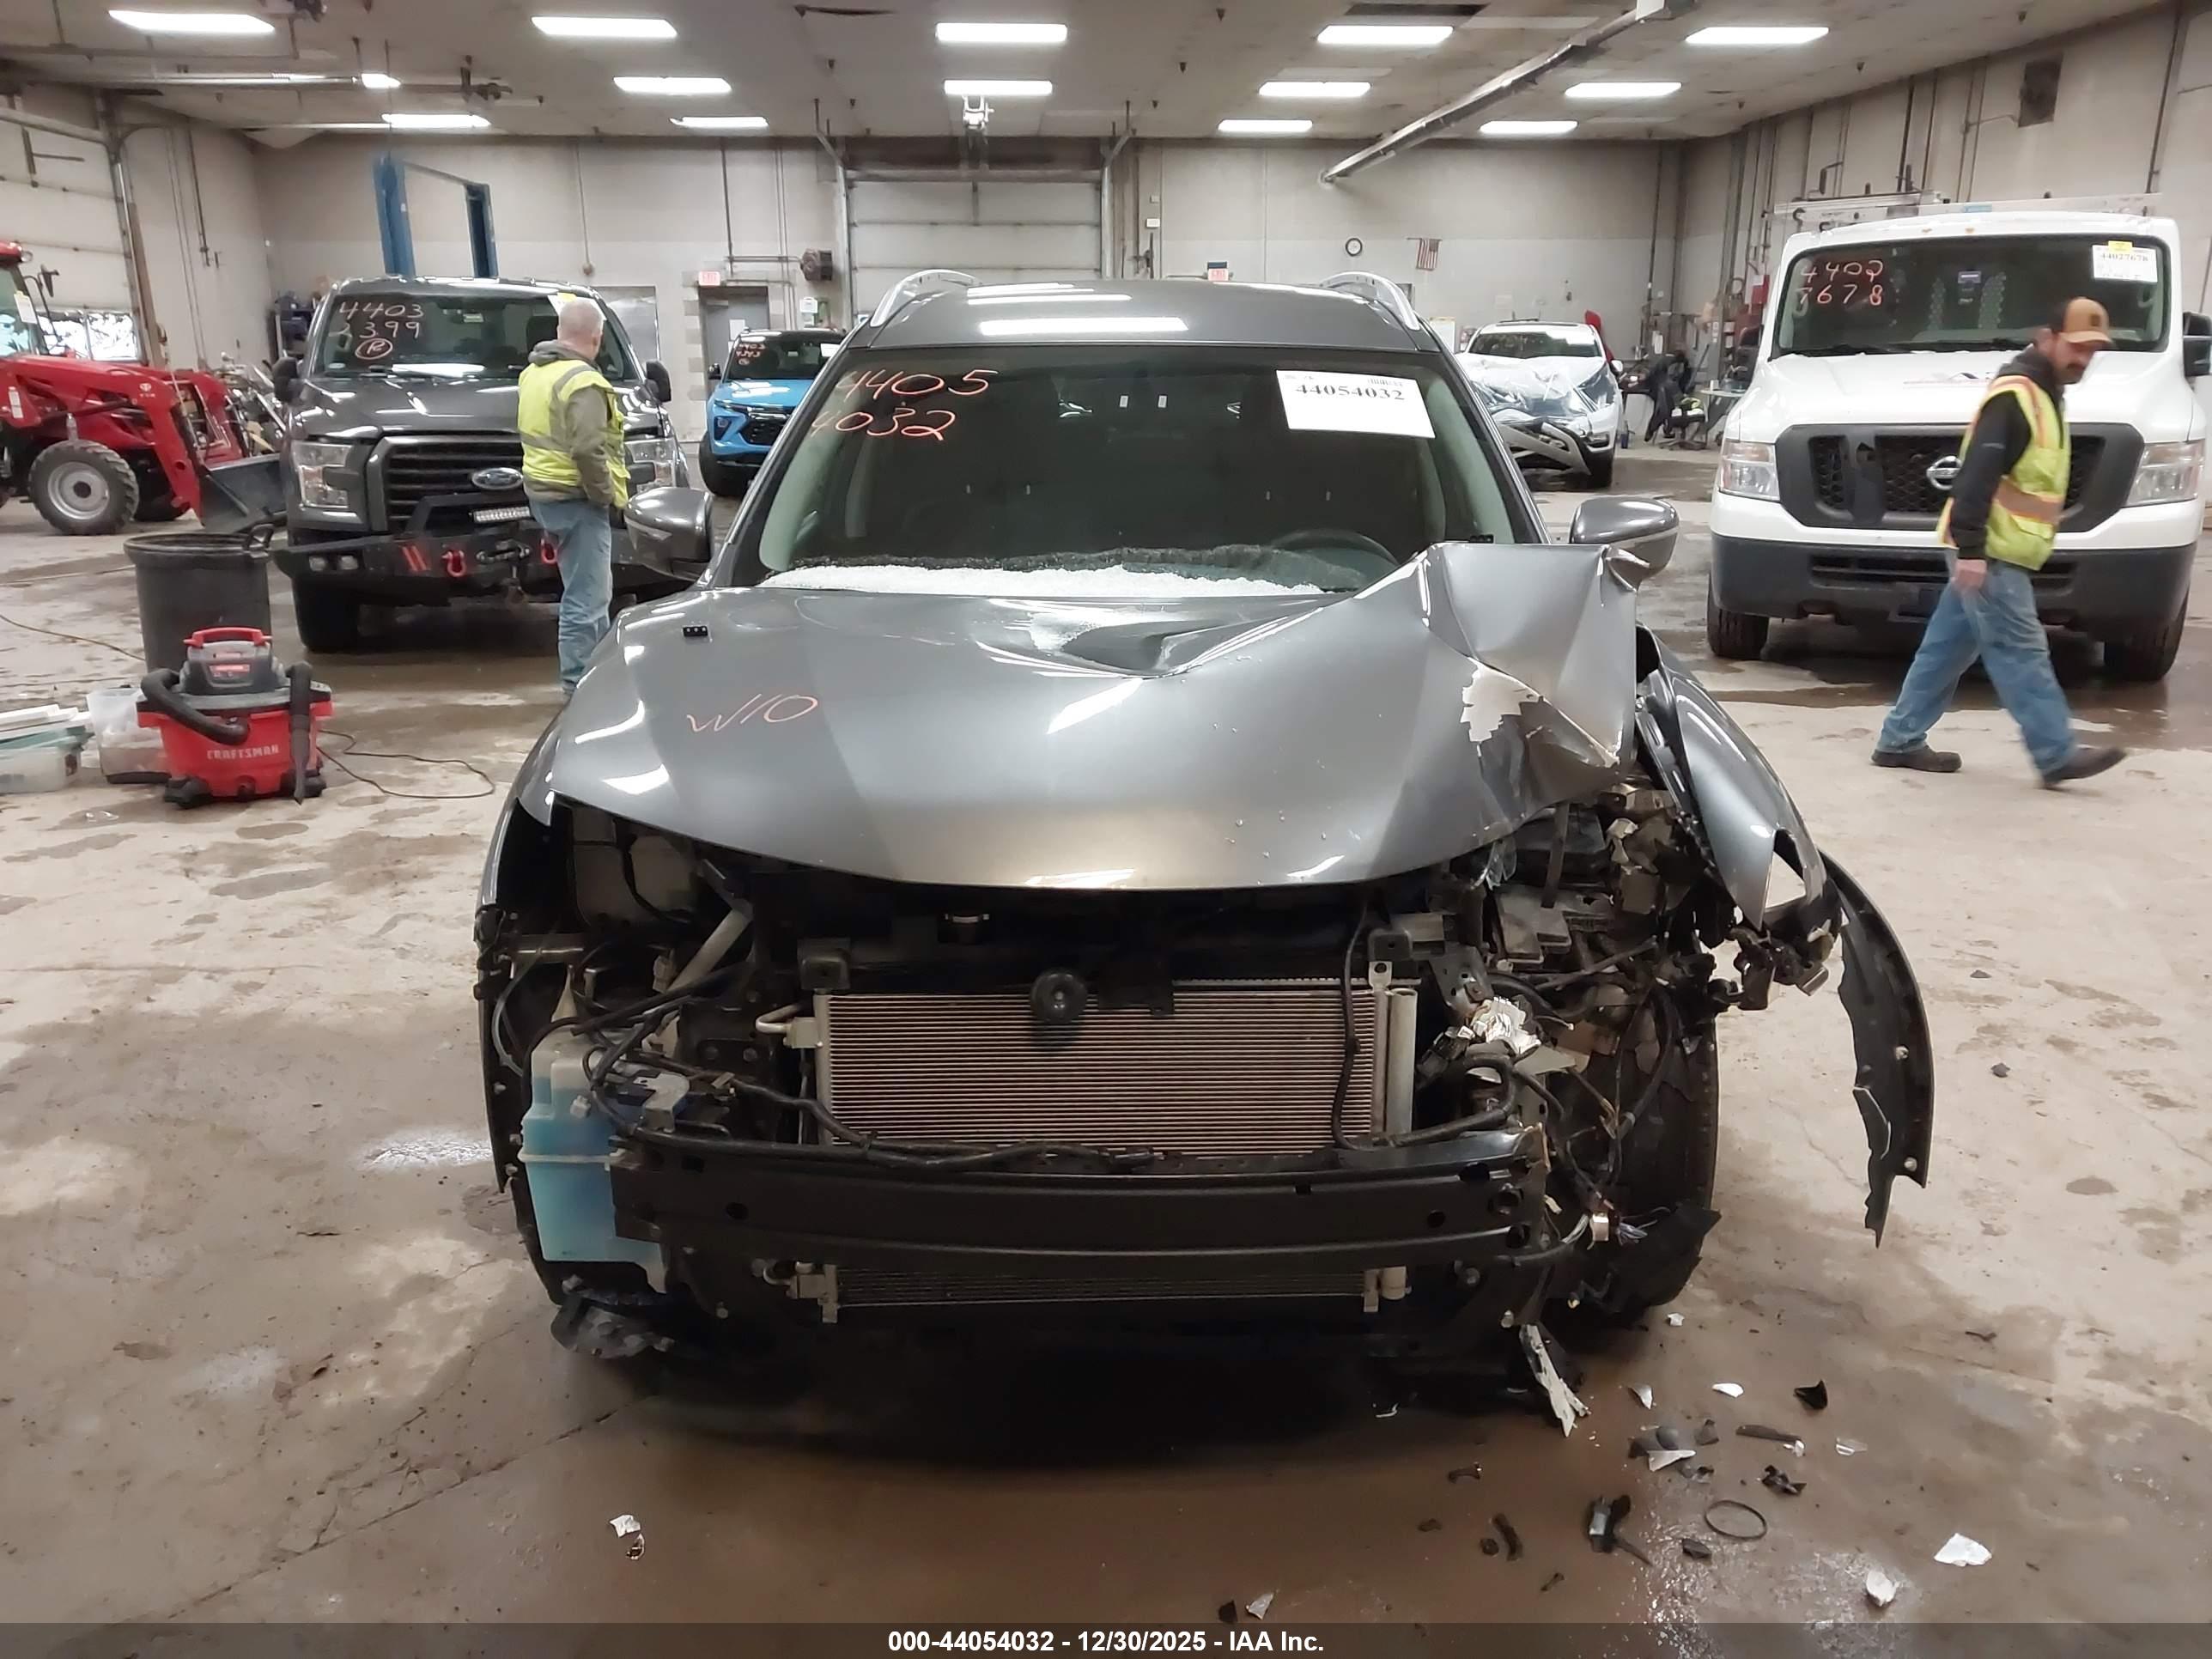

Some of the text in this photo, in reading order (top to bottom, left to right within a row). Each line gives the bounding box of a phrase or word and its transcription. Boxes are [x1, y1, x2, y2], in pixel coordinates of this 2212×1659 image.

[1795, 283, 1883, 306] 7678
[339, 301, 424, 319] 4403
[836, 368, 999, 403] 4405
[1295, 384, 1405, 400] 44054032
[811, 407, 957, 441] 4032
[207, 744, 279, 760] CRAFTSMAN
